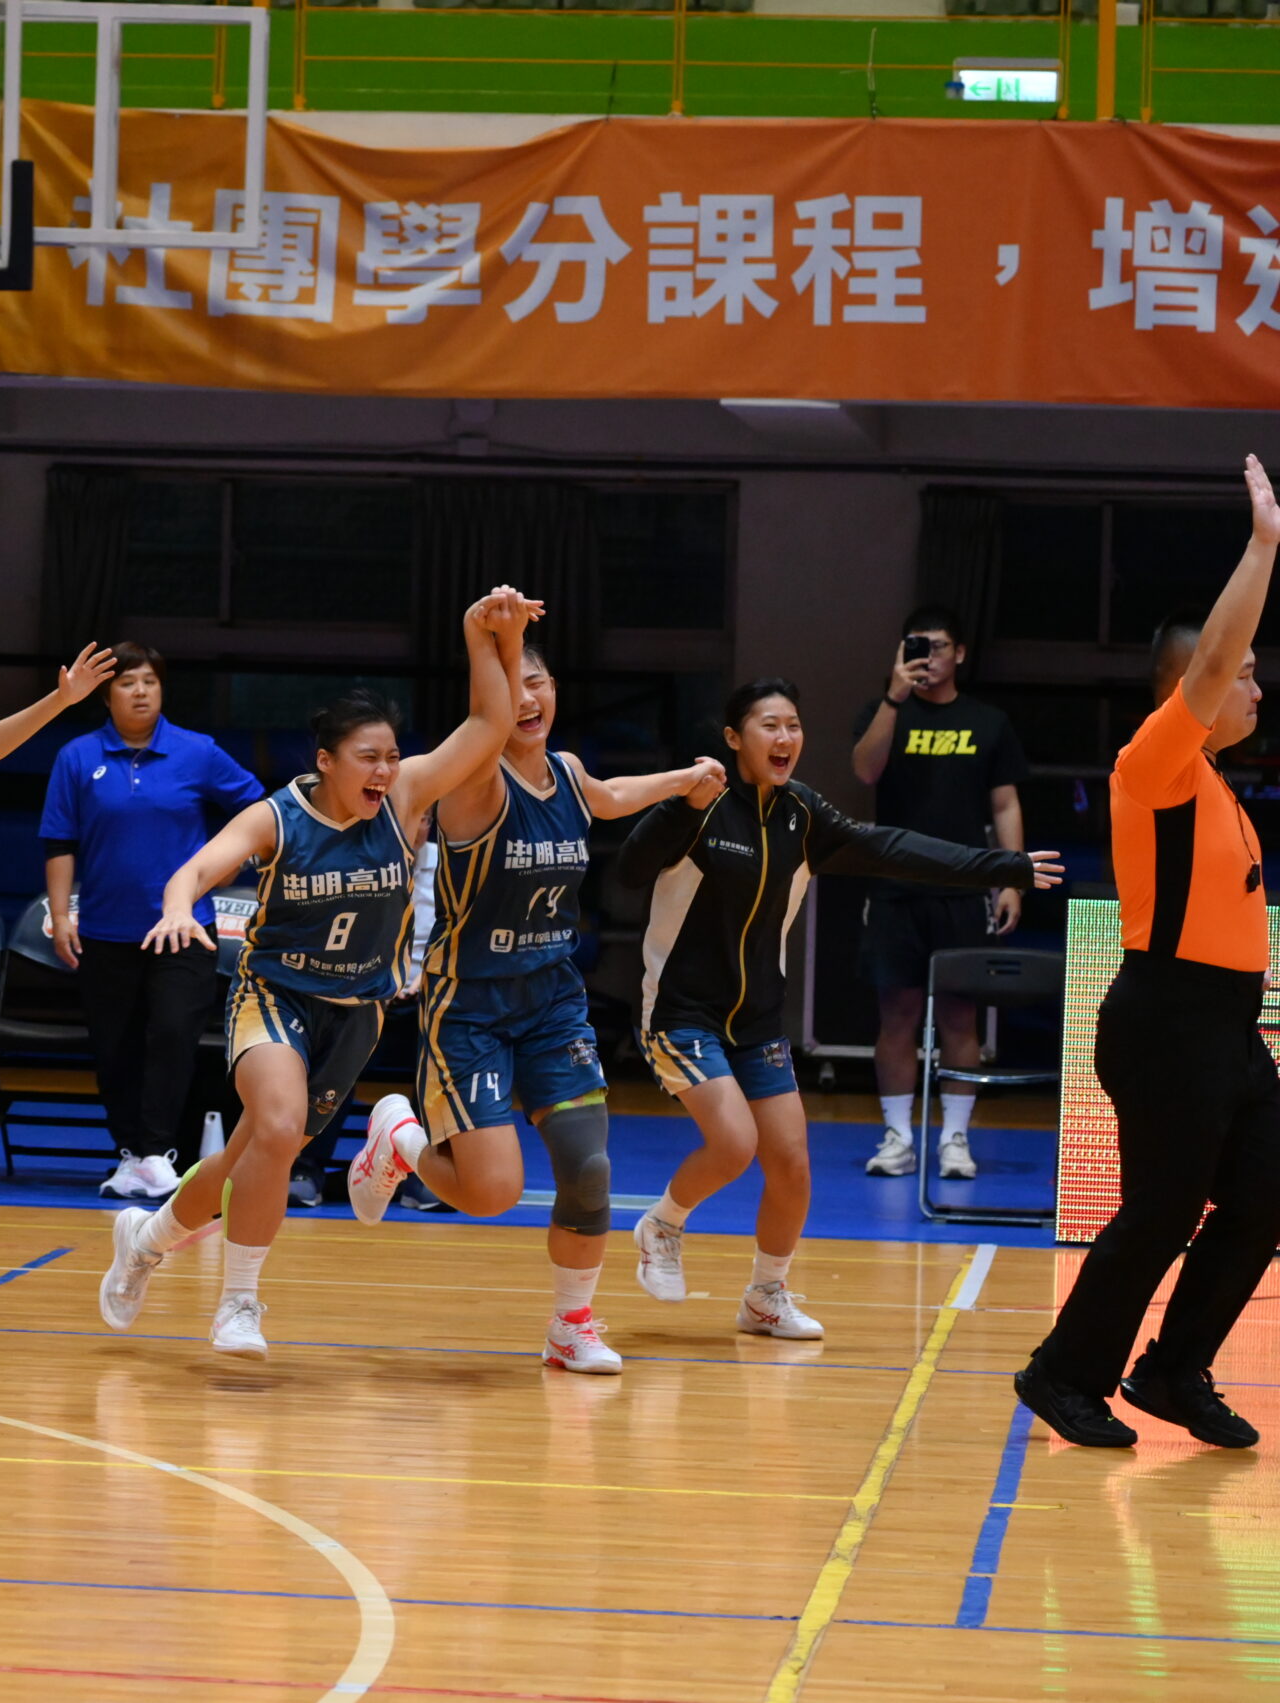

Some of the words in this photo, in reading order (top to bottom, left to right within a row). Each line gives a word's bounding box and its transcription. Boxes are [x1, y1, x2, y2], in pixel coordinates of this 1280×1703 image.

[905, 729, 977, 755] HBL
[283, 861, 402, 901] 忠明高中
[325, 912, 358, 951] 8
[470, 1072, 501, 1103] 14
